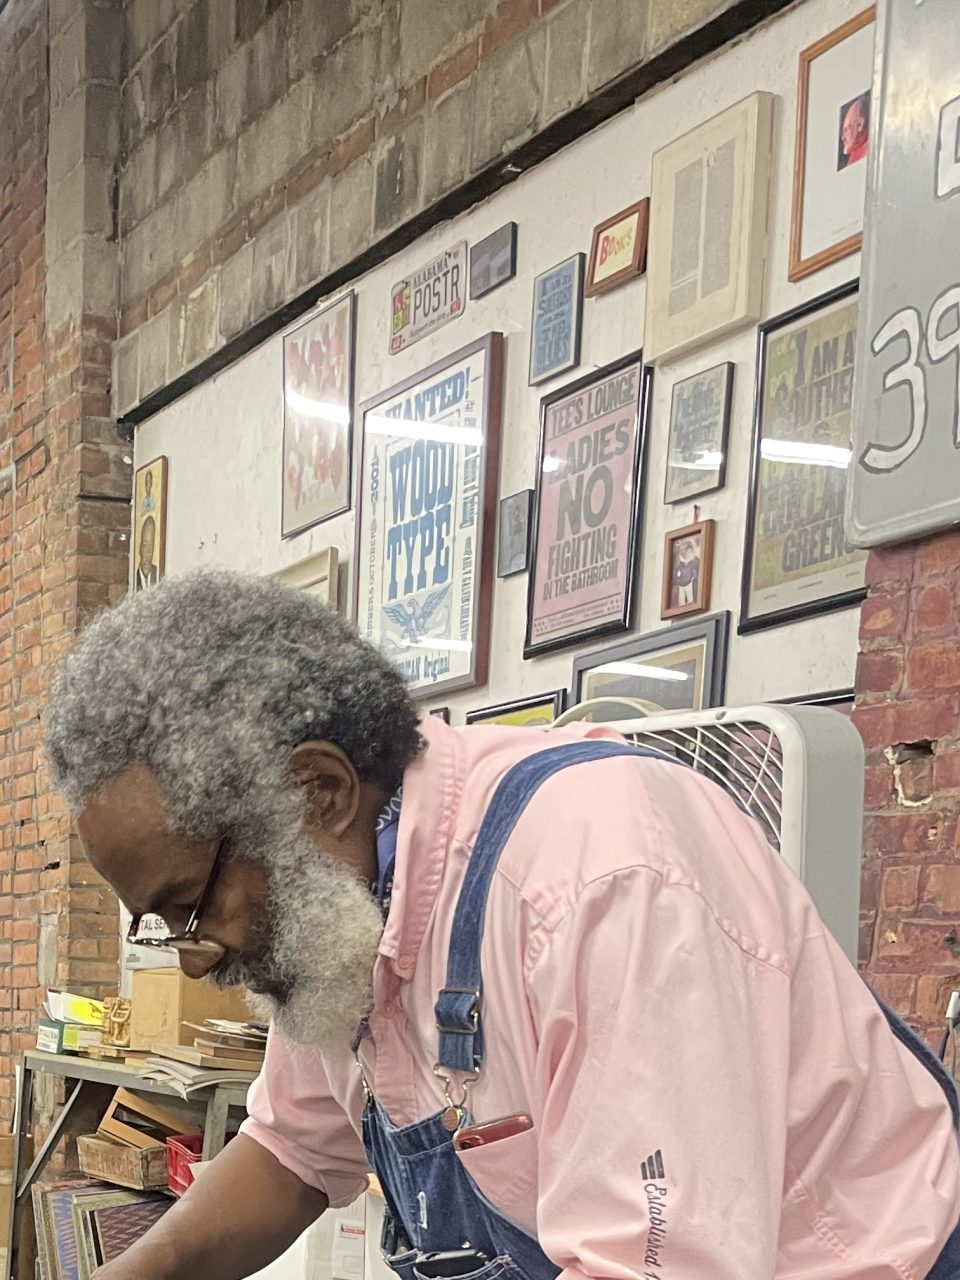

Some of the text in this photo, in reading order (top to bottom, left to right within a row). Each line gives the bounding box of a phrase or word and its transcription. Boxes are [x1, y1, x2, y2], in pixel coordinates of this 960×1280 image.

[412, 256, 448, 290] ALABAMA
[413, 264, 460, 325] POSTR
[551, 371, 636, 437] TEE'S LOUNGE
[389, 438, 455, 524] WOOD
[556, 464, 614, 542] NO
[386, 504, 451, 602] TYPE
[547, 523, 618, 580] FIGHTING
[782, 515, 855, 573] GREEN
[543, 558, 618, 601] IN THE BATHROOM
[643, 1182, 668, 1268] Established
